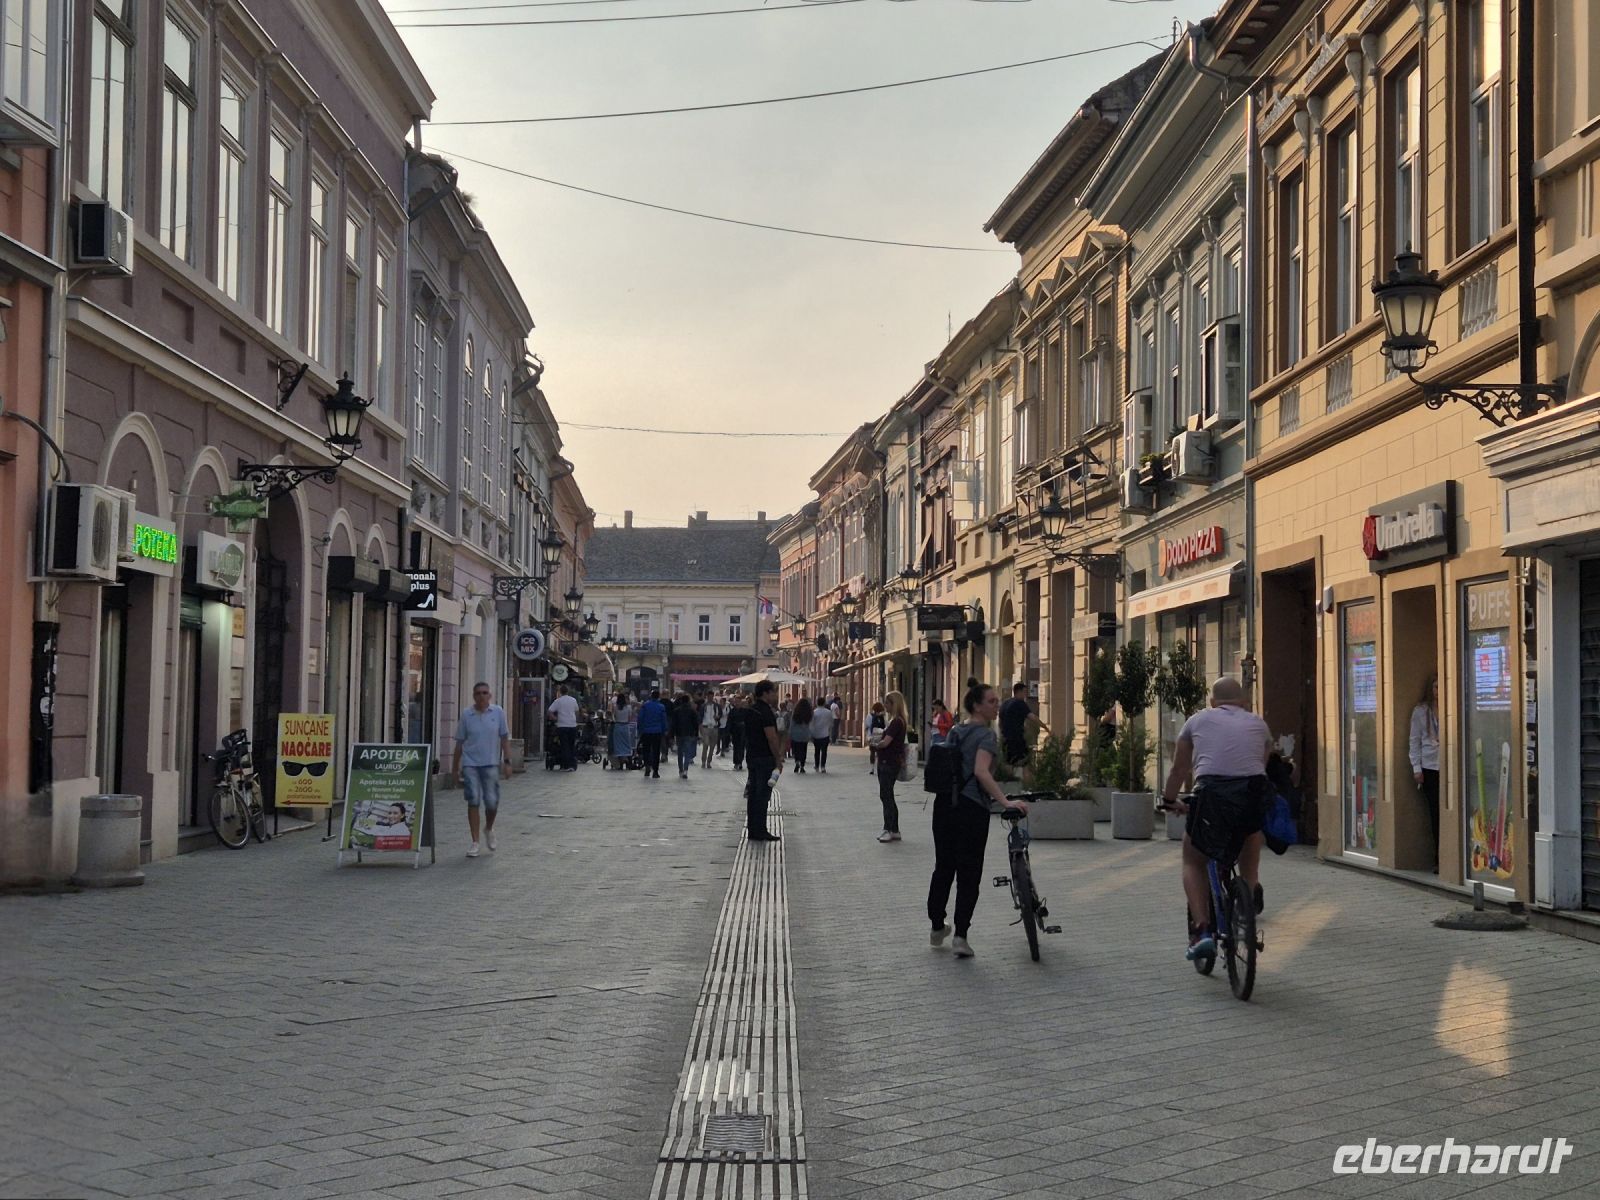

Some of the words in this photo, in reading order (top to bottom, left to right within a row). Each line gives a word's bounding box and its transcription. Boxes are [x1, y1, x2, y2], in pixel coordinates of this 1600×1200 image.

[1376, 502, 1435, 551] Umbrella
[1166, 538, 1190, 568] DODO
[1189, 526, 1217, 560] PIZZA
[410, 581, 430, 592] plus
[360, 749, 420, 760] APOTEKA
[388, 778, 415, 786] LAURUS
